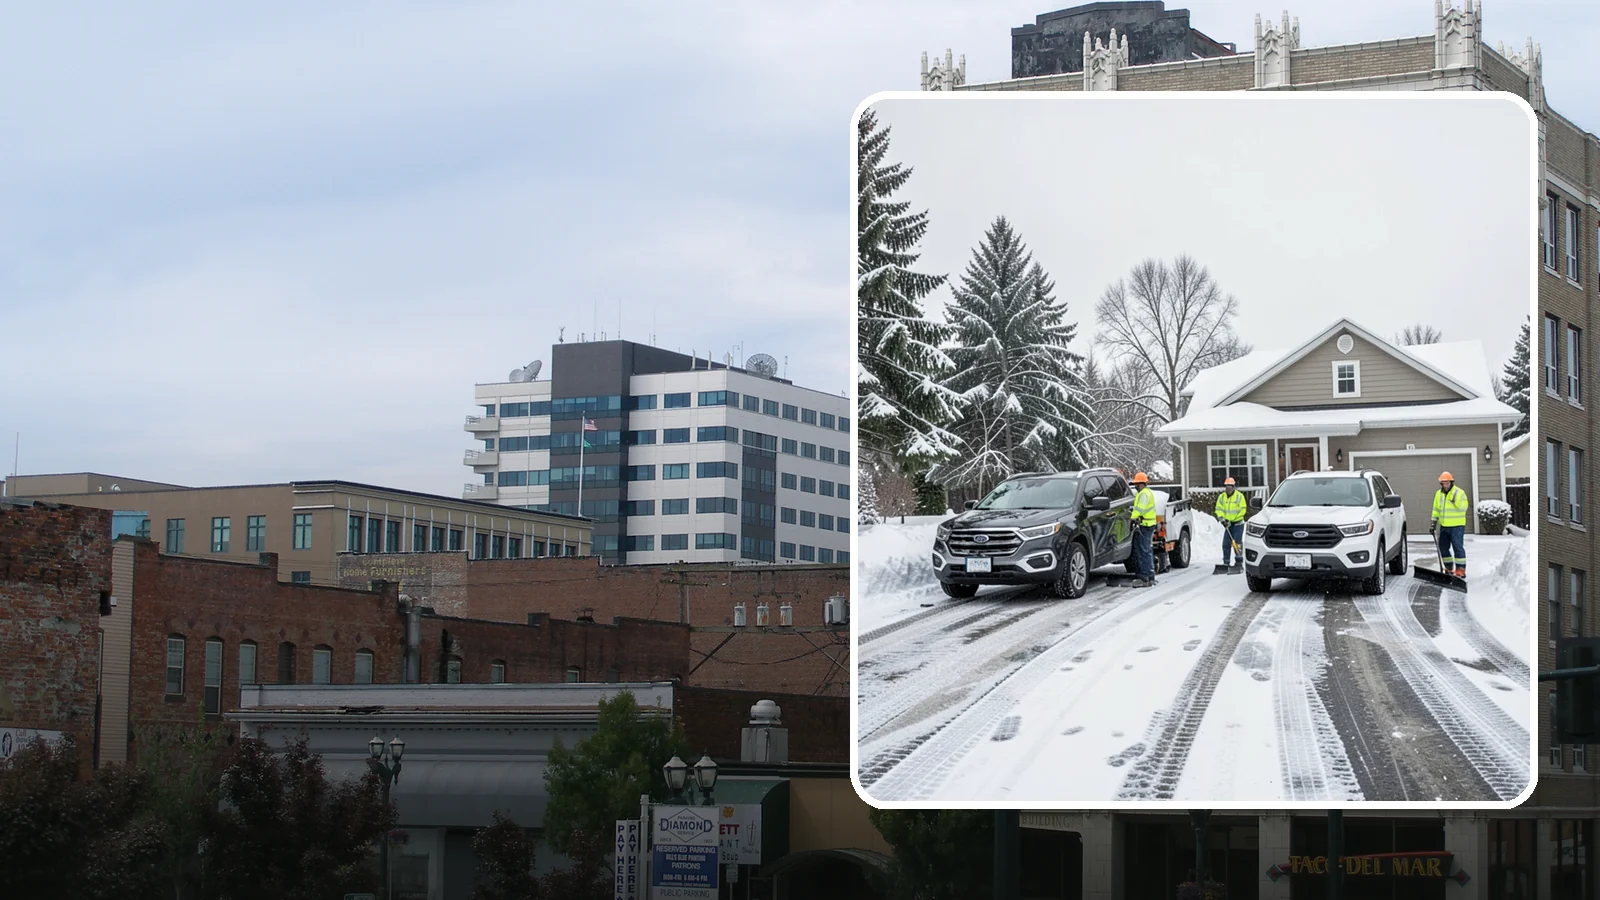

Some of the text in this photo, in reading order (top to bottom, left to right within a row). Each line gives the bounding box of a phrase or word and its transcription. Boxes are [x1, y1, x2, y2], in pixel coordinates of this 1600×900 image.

[343, 566, 427, 577] Home Furnishers
[660, 818, 713, 833] DIAMOND
[1022, 815, 1070, 828] BUILDING
[655, 845, 716, 854] RESERVED PARKING
[617, 825, 625, 893] PAY HERE
[627, 825, 637, 893] PAY HERE
[721, 851, 739, 862] Soup
[671, 862, 701, 870] PATRONS
[1289, 855, 1443, 877] TAC DEL MAR
[660, 888, 710, 898] PUBLIC PARKING
